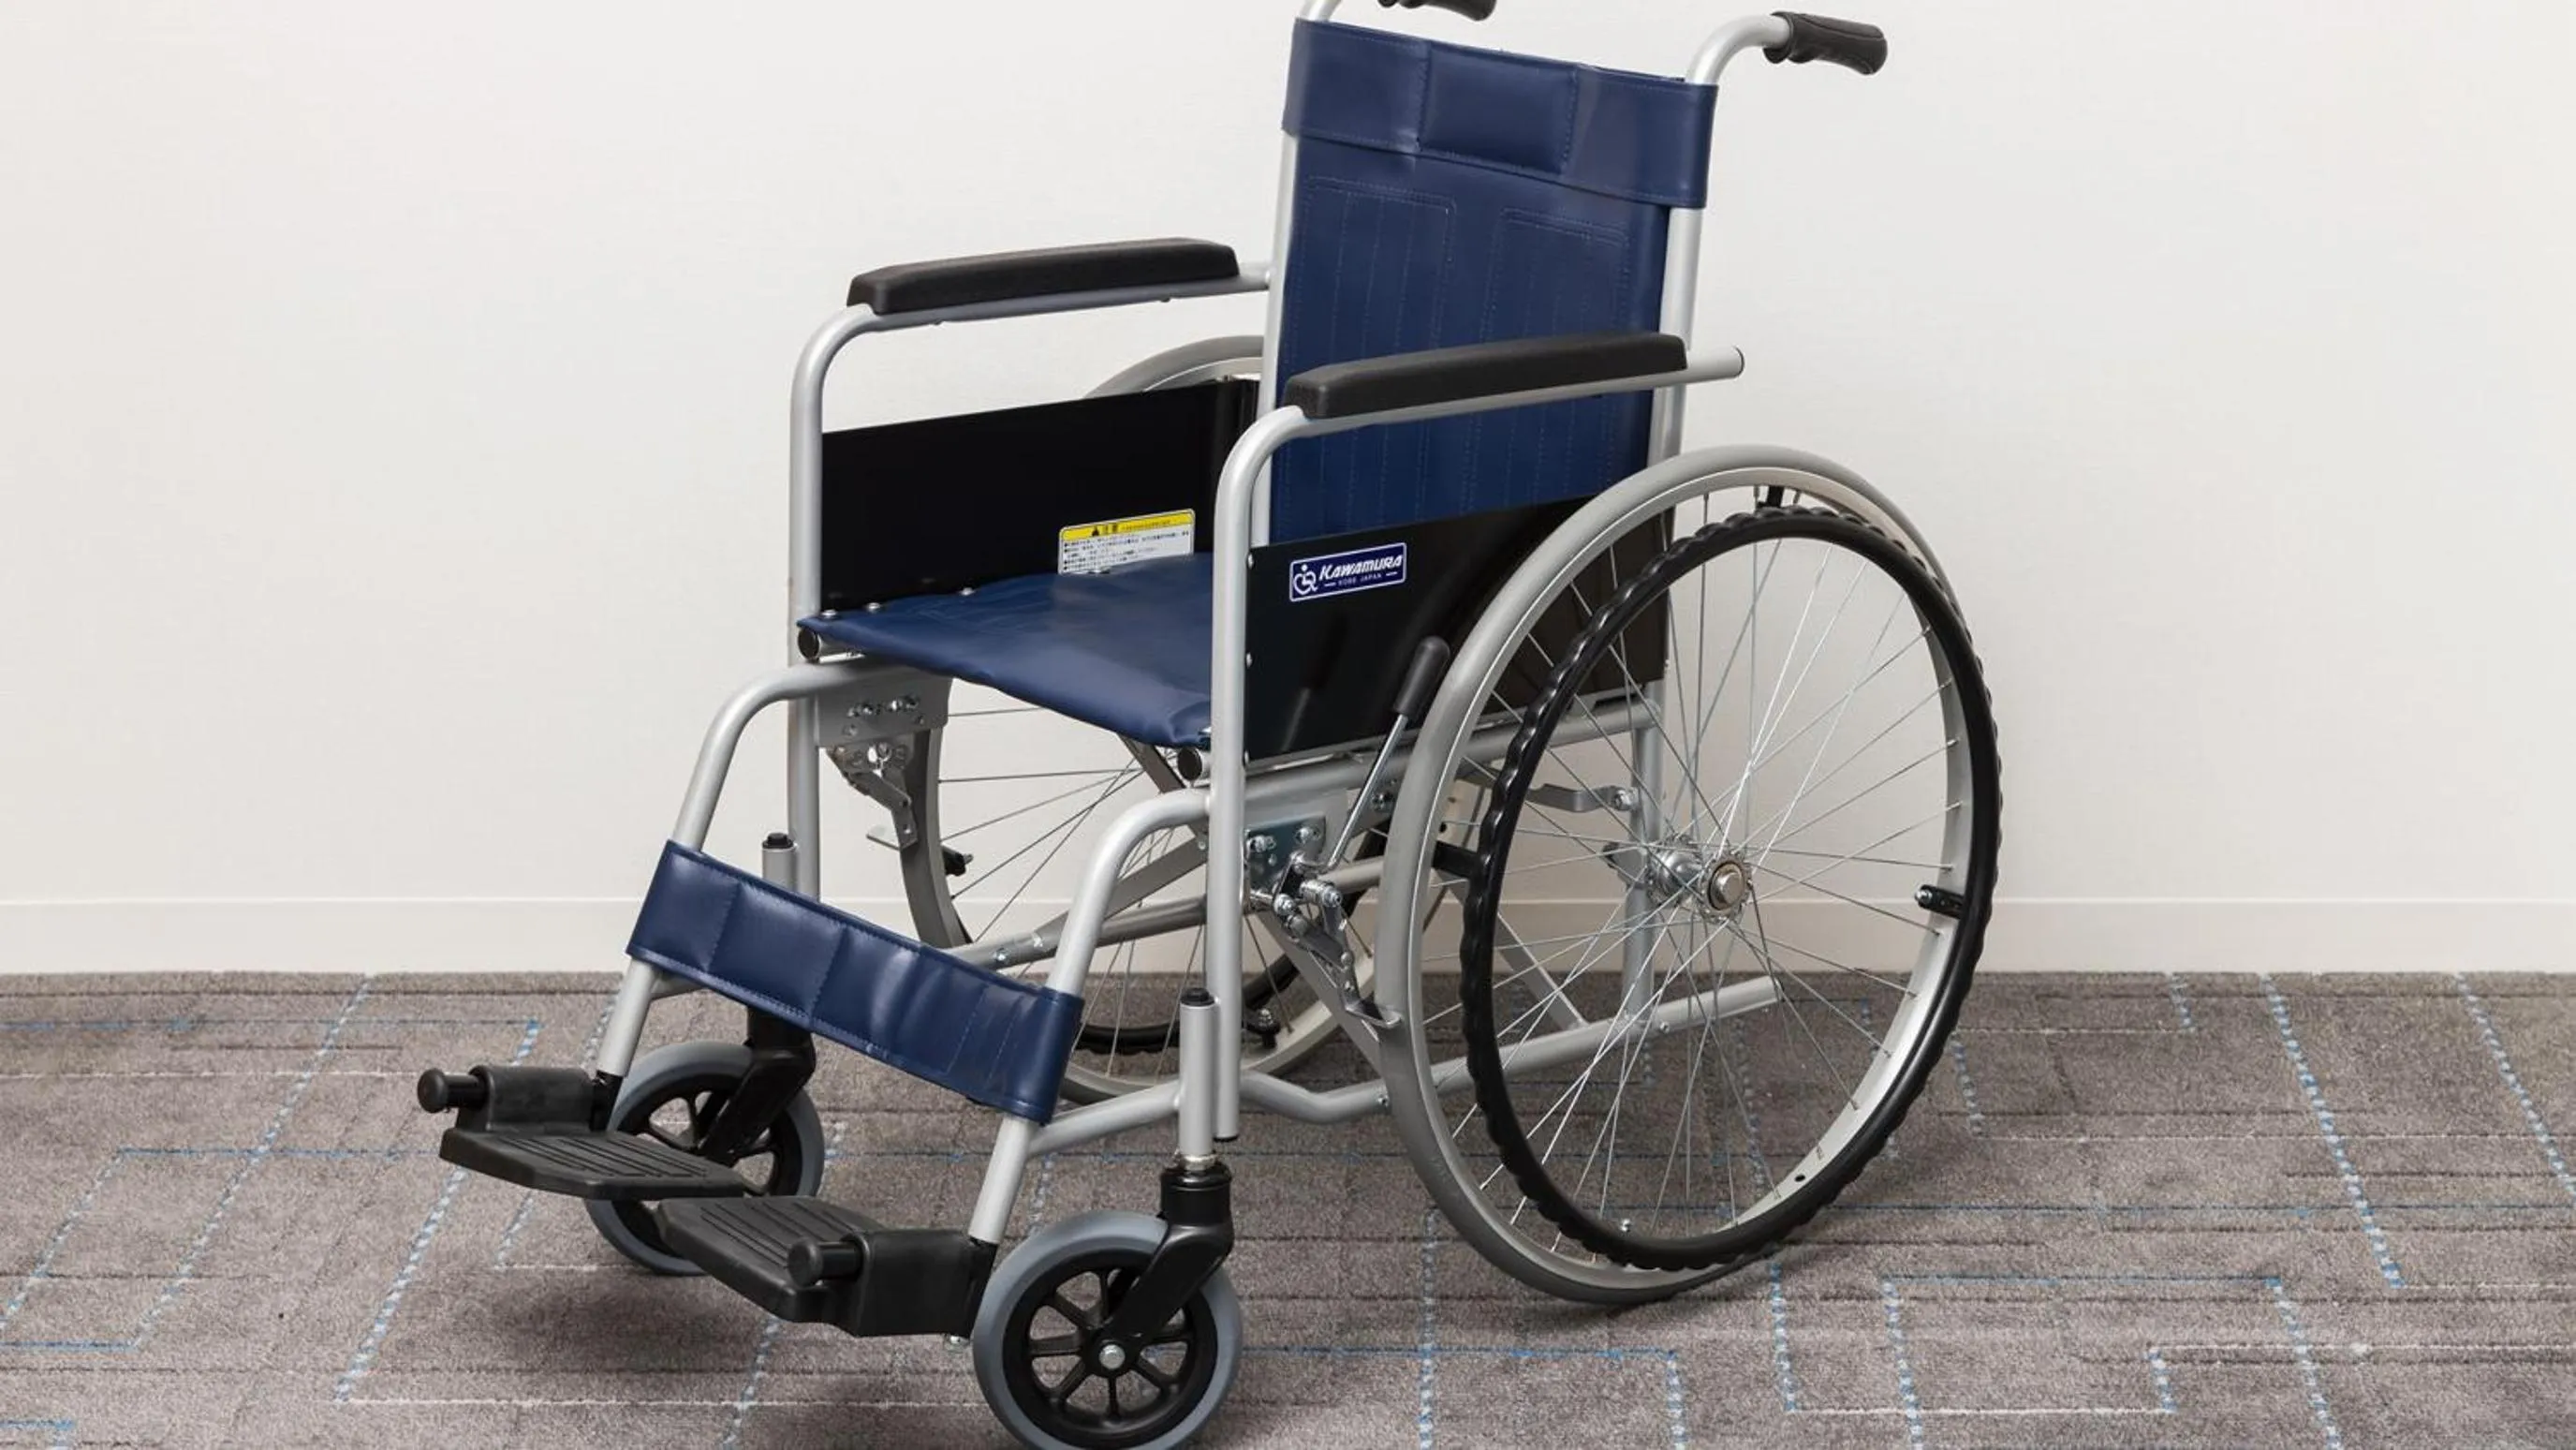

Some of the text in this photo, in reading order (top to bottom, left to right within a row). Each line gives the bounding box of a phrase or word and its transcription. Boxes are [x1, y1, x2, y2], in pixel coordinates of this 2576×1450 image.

[1318, 555, 1403, 581] KAWAMURA
[1338, 572, 1382, 586] KOBE JAPAN
